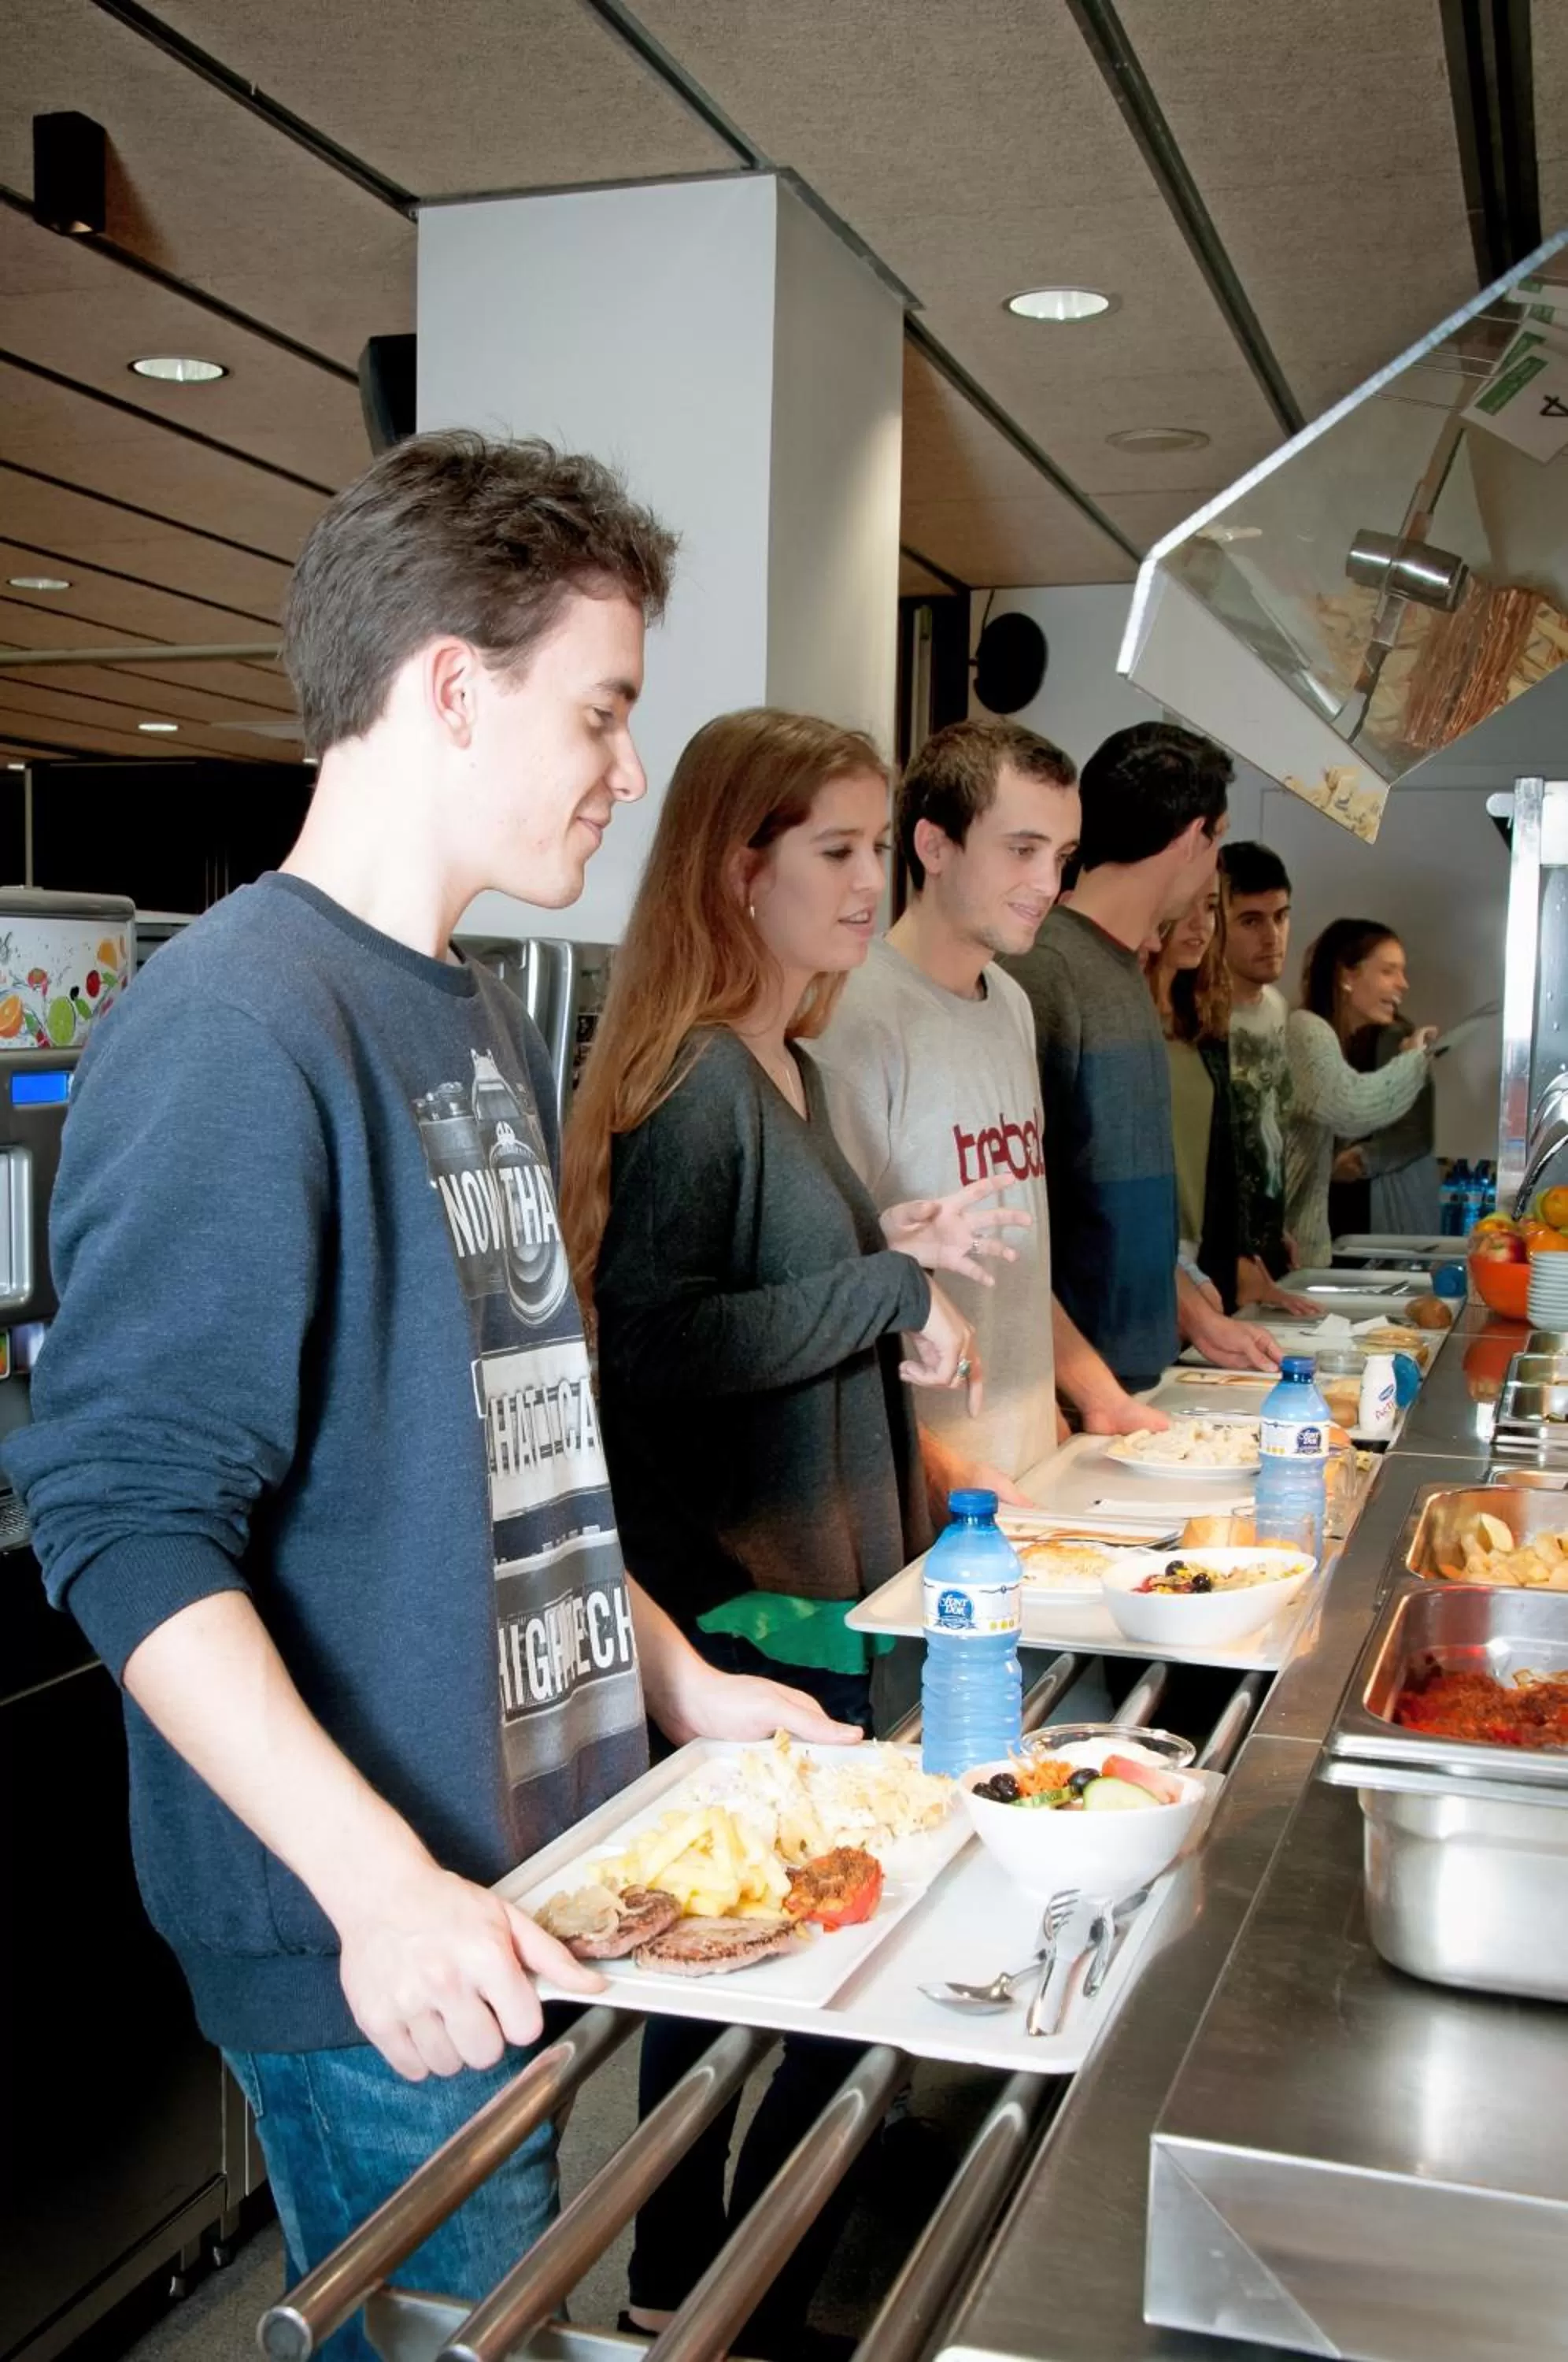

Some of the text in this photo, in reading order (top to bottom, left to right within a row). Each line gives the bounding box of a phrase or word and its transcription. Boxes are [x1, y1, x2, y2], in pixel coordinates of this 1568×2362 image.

[438, 1164, 561, 1257] NOW THA
[557, 1375, 605, 1459] CA
